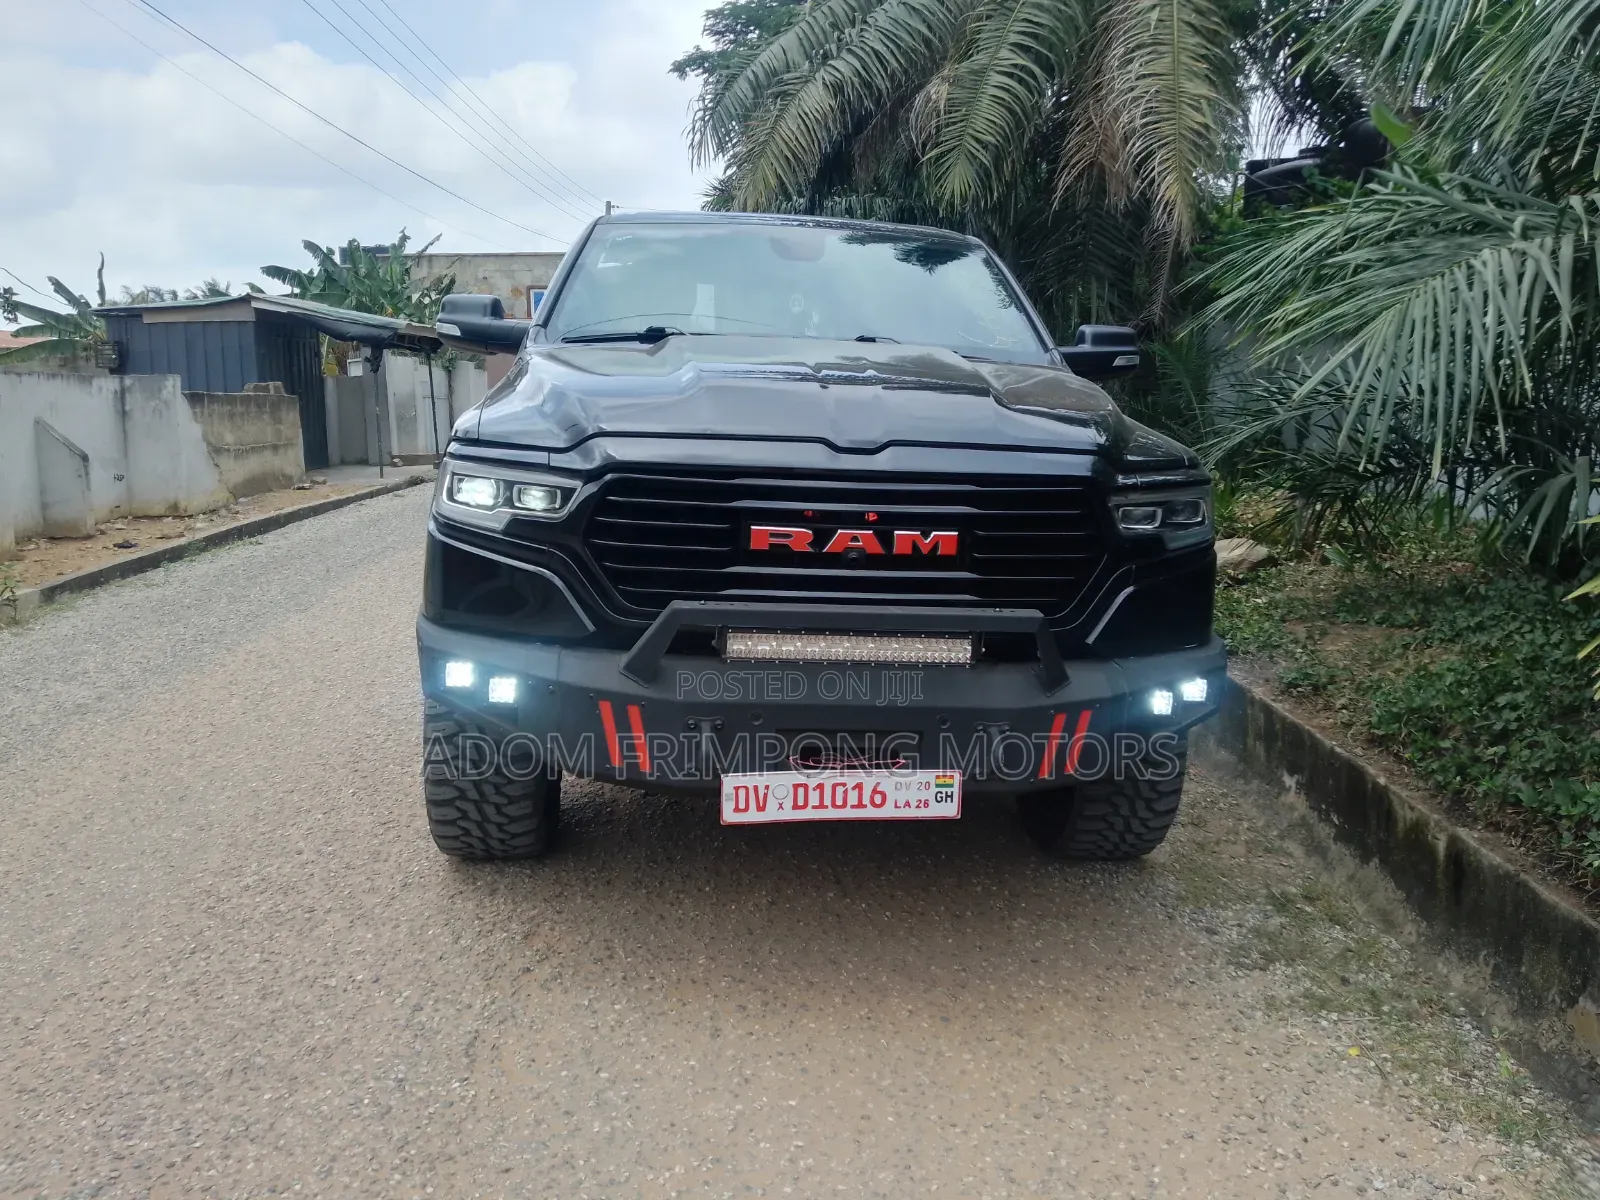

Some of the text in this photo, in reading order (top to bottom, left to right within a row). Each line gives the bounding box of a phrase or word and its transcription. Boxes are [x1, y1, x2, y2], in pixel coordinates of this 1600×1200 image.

[750, 525, 959, 556] RAM
[894, 781, 931, 791] DV 20
[733, 782, 888, 813] DV D1016
[893, 799, 930, 809] LA 26
[934, 790, 954, 804] GH
